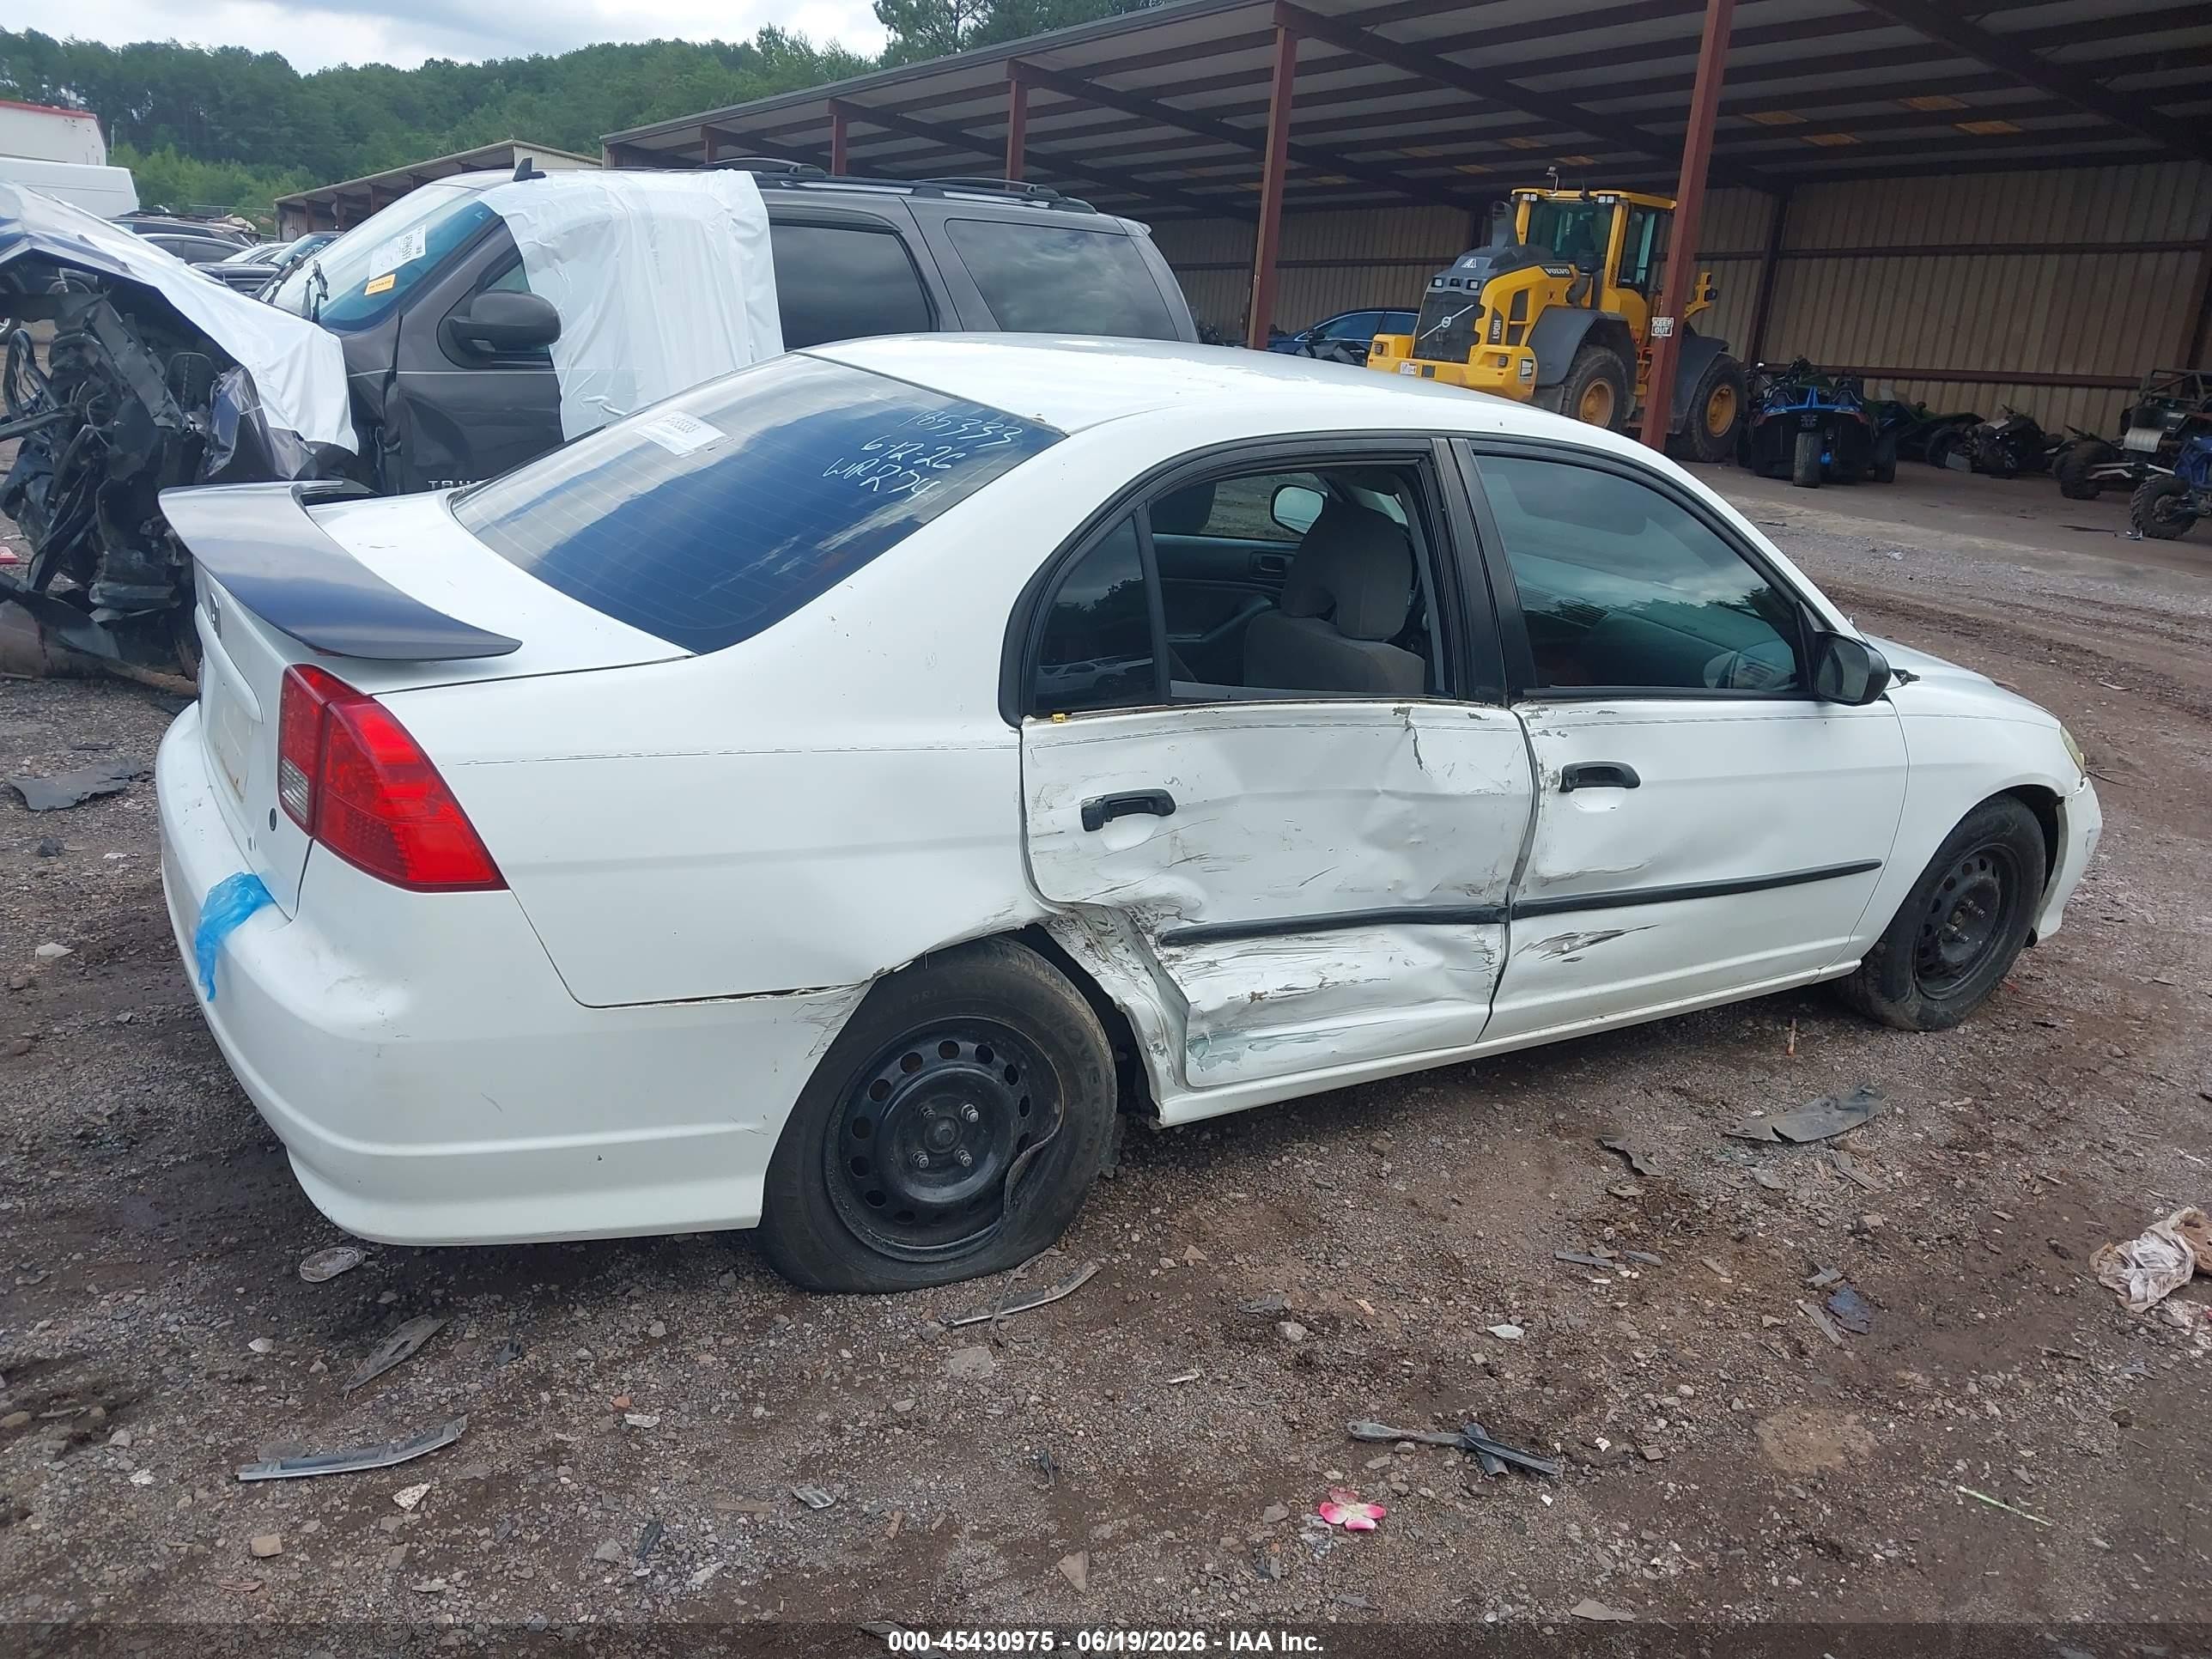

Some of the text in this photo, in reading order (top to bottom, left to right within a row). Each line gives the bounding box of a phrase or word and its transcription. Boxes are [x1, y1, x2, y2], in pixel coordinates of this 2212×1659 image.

[1492, 319, 1502, 339] L90H
[896, 410, 1024, 448] 185333
[860, 434, 967, 469] 6-12-26
